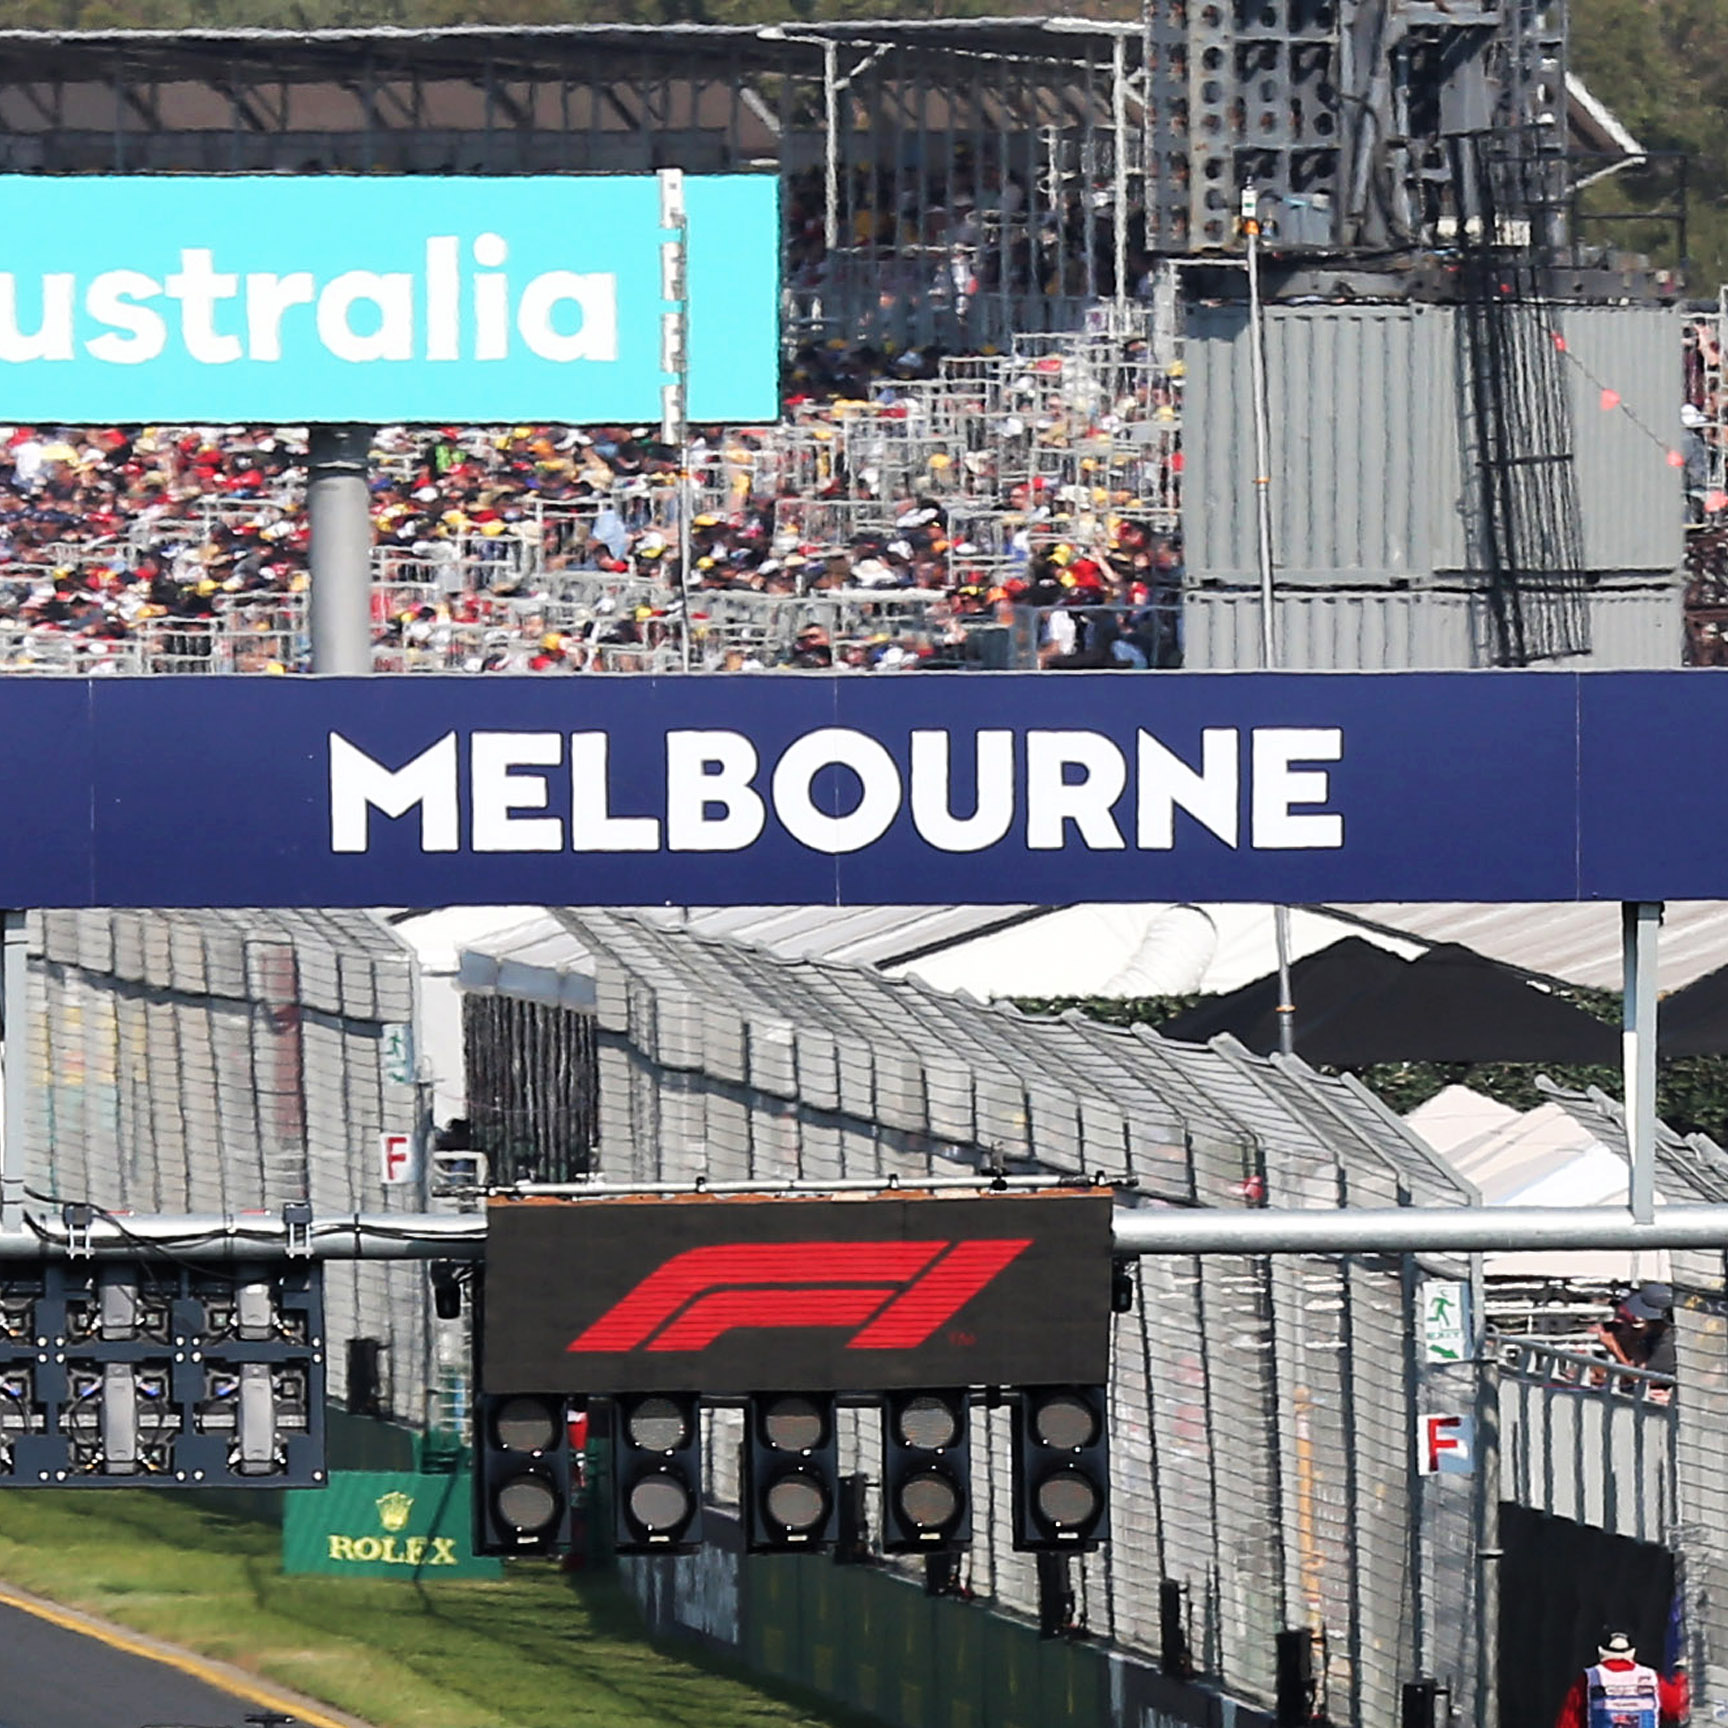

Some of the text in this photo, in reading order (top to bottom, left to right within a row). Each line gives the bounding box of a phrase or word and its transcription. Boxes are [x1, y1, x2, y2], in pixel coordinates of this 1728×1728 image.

[329, 728, 1343, 854] MELBOURNE
[386, 1136, 408, 1180] F
[565, 1238, 1035, 1353] F1
[1427, 1416, 1462, 1473] F
[328, 1534, 459, 1567] ROLEX
